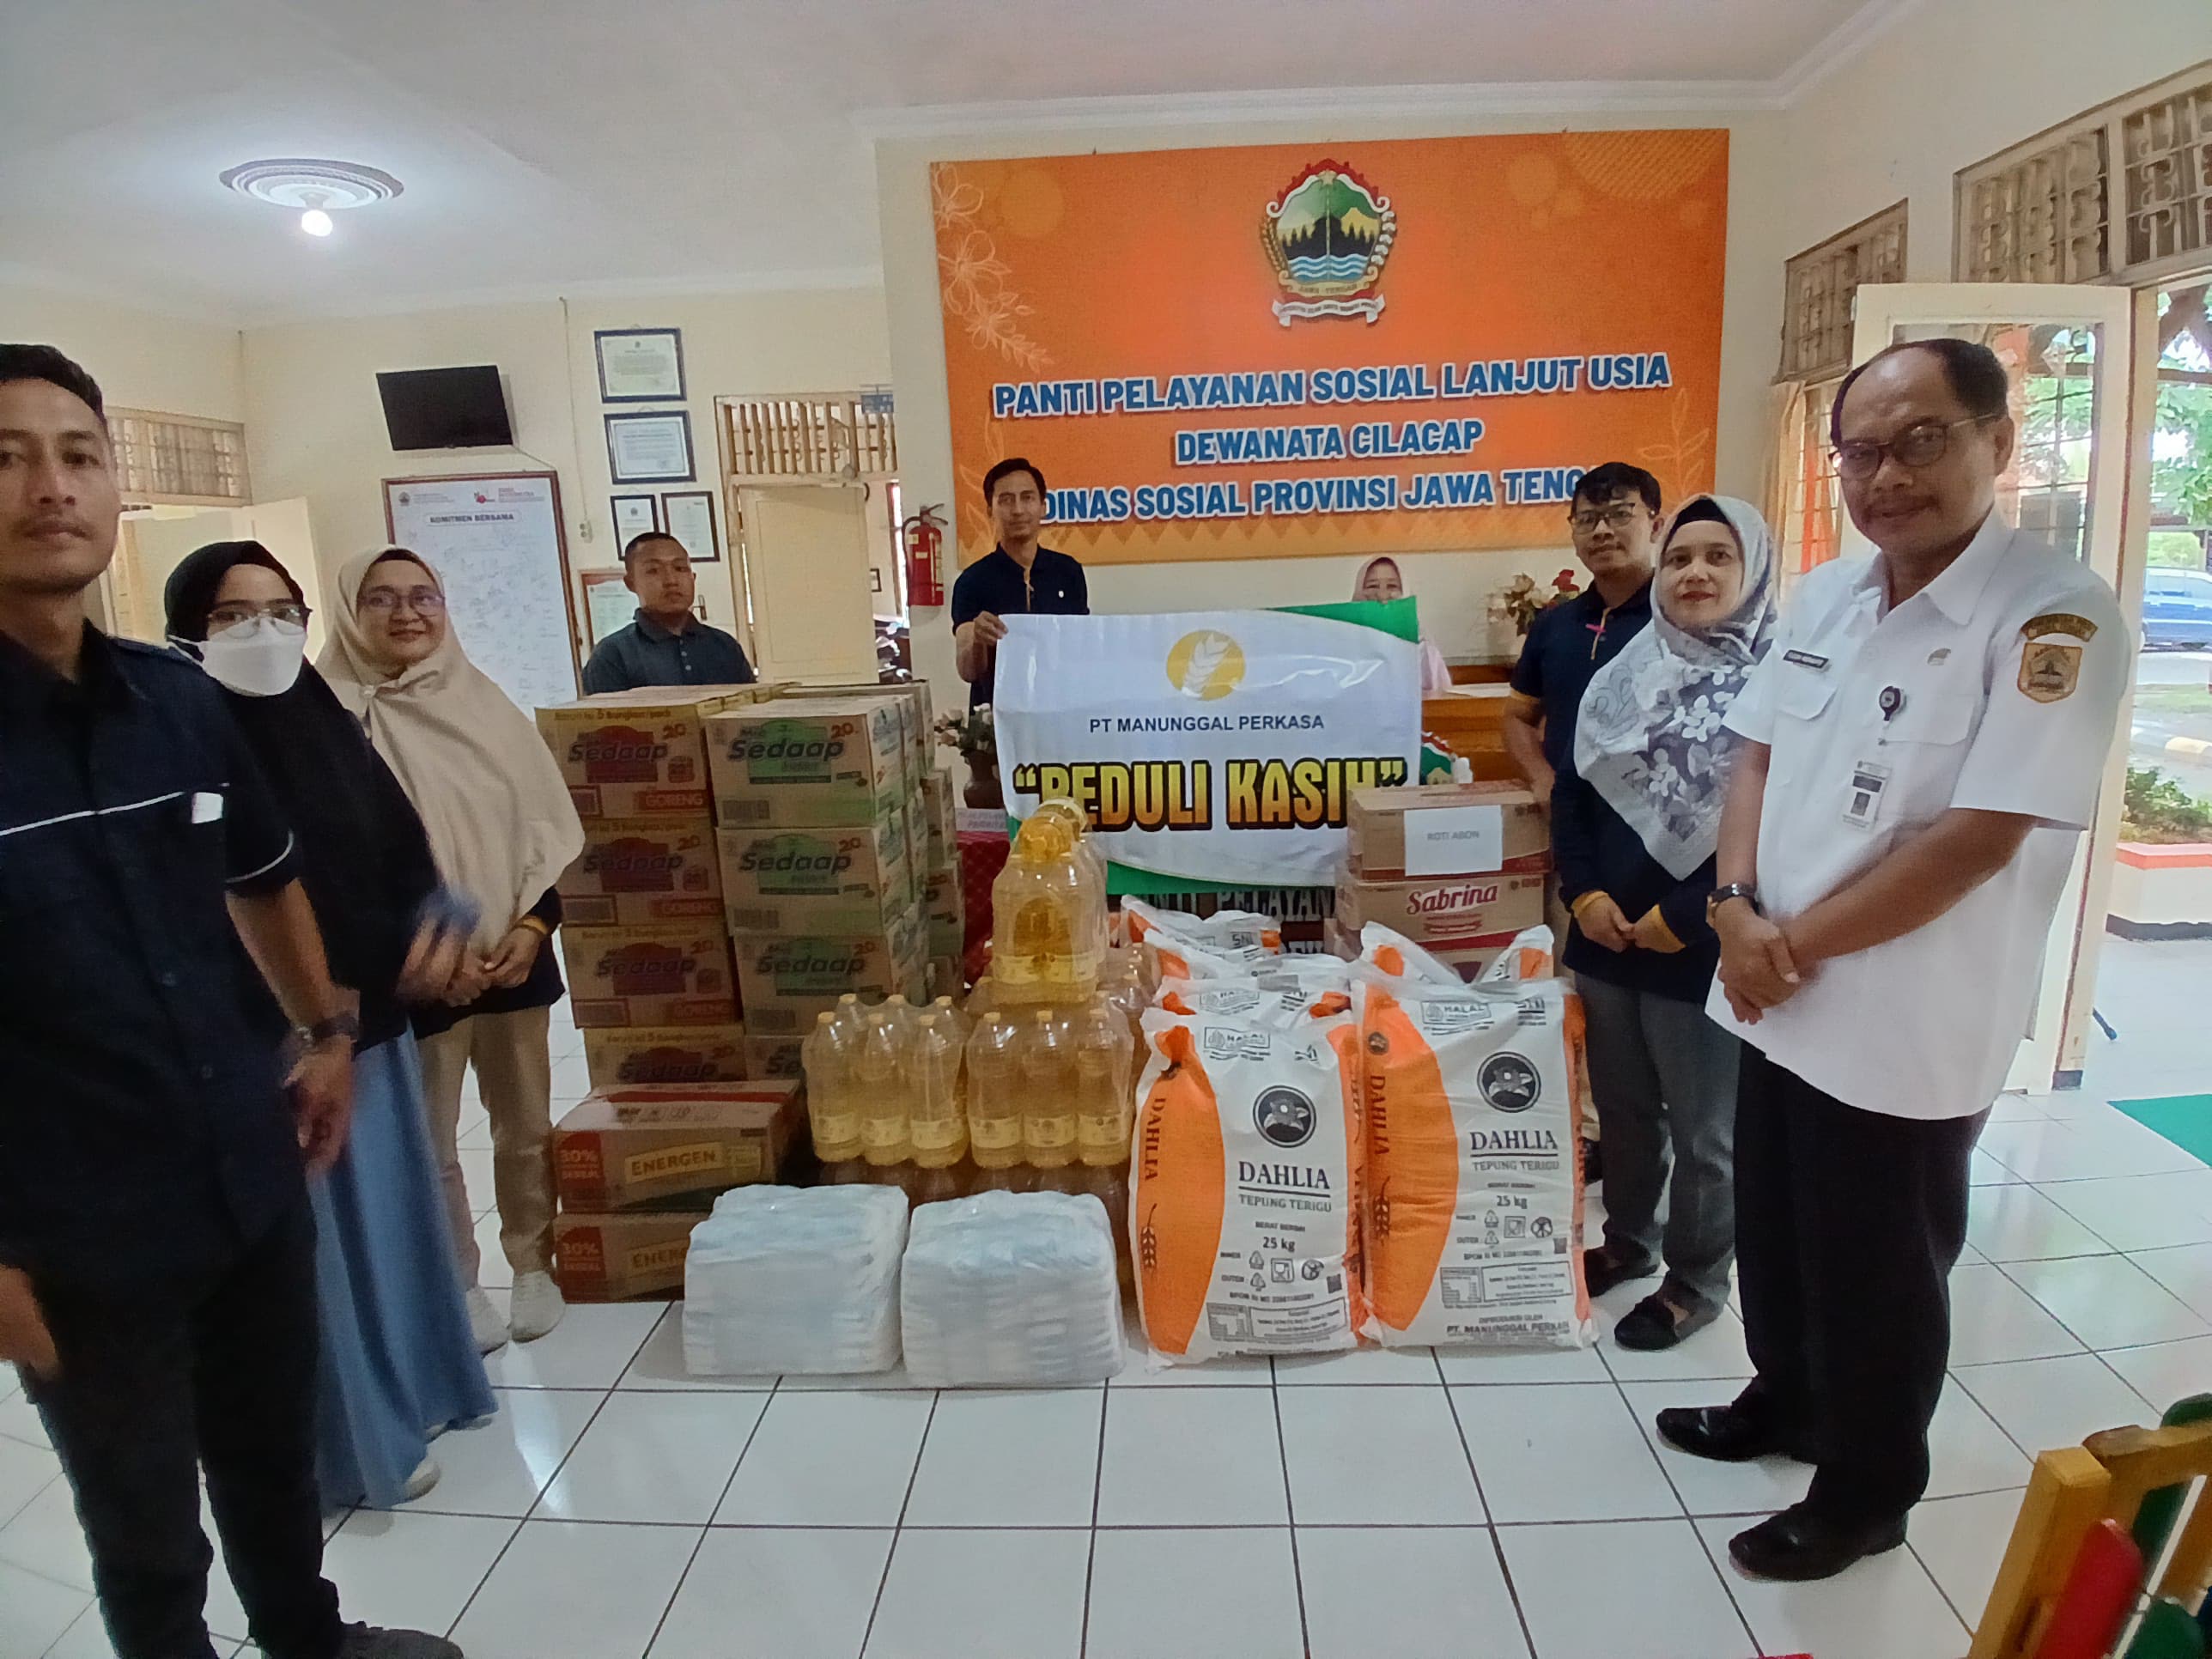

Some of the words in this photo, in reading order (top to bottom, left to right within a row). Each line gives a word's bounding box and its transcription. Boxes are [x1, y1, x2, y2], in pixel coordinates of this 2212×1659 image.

[994, 381, 1096, 417] PANTI
[1103, 371, 1305, 411] PELAYANAN
[1313, 364, 1437, 404] SOSIAL
[1443, 356, 1583, 397] LANJUT
[1588, 352, 1672, 389] USIA
[1176, 424, 1346, 465] DEWANATA
[1351, 418, 1485, 457] CILACAP
[1042, 486, 1129, 524] DINAS
[1134, 482, 1246, 520] SOSIAL
[1251, 473, 1396, 516] PROVINSI
[1402, 470, 1494, 509] JAWA
[429, 514, 473, 524] KOMITMEN
[474, 512, 514, 522] BERSAMA
[830, 722, 854, 739] 20
[1090, 718, 1112, 732] PT
[1117, 716, 1234, 732] MANUNGGAL
[1239, 714, 1325, 730] PERKASA
[568, 740, 669, 763] Sedaap
[727, 738, 845, 762] Sedaap
[645, 793, 704, 806] GORENG
[837, 837, 862, 852] 20
[738, 852, 853, 875] Sedaap
[1407, 884, 1498, 915] Sabrina
[756, 955, 866, 976] Sedaap
[1443, 1002, 1486, 1013] HALAL
[1370, 1075, 1390, 1156] DAHLIA
[1145, 1097, 1167, 1182] DAHLIA
[1469, 1129, 1559, 1152] DAHLIA
[631, 1150, 716, 1176] ENERGEN
[1472, 1161, 1517, 1171] TEPUNG
[1520, 1160, 1560, 1171] TERIGU
[1238, 1161, 1330, 1189] DAHLIA
[1238, 1194, 1286, 1208] TEPUNG
[1289, 1198, 1332, 1212] TERIGU
[1496, 1194, 1511, 1207] 25
[1514, 1196, 1528, 1209] kg
[1262, 1236, 1278, 1249] 25
[1281, 1237, 1296, 1252] kg
